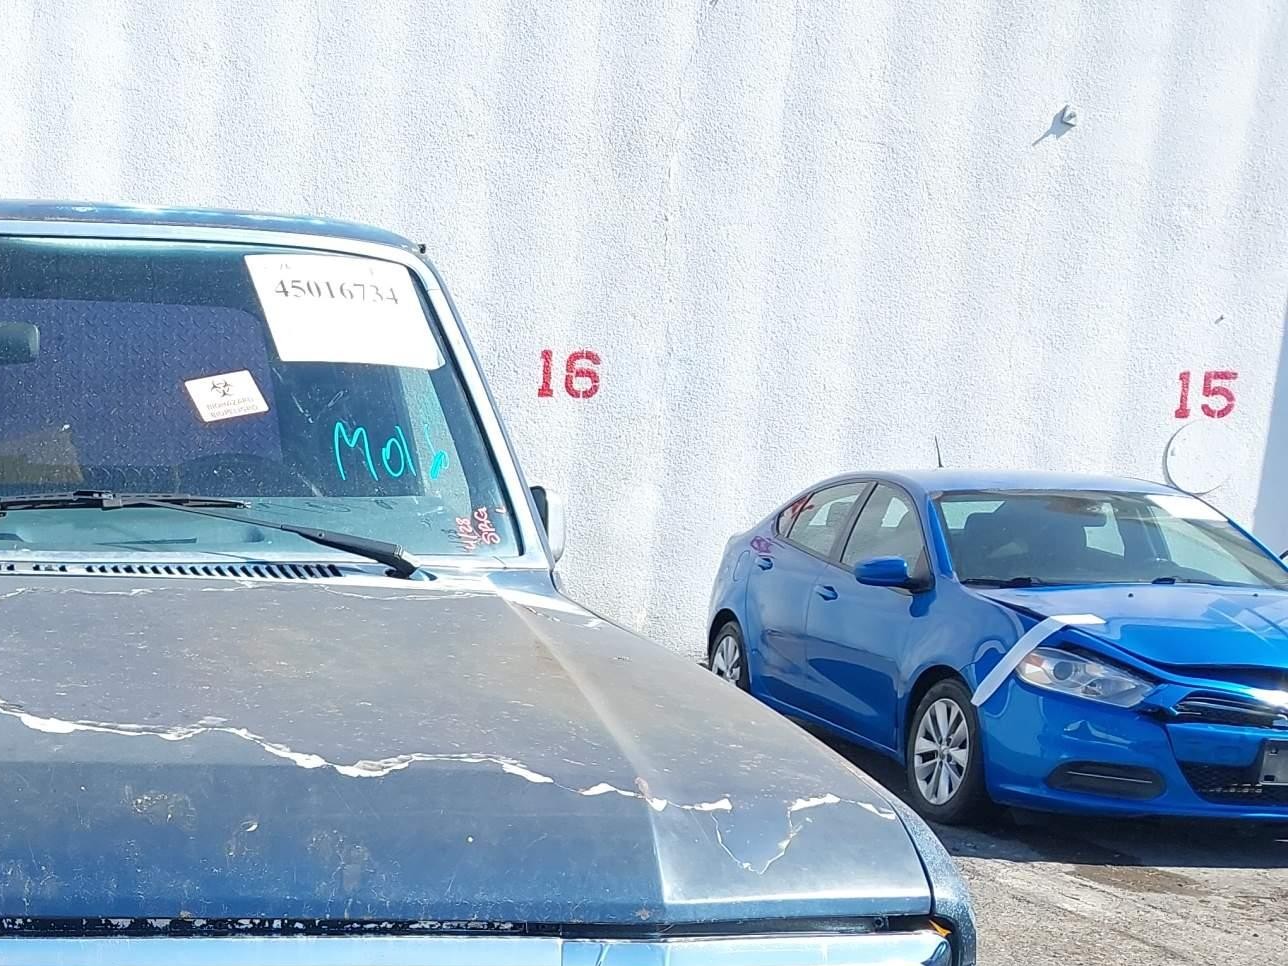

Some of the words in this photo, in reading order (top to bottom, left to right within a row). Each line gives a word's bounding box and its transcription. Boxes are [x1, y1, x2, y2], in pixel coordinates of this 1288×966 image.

[274, 279, 399, 304] 45016734
[537, 349, 601, 399] 16
[1173, 370, 1238, 419] 15
